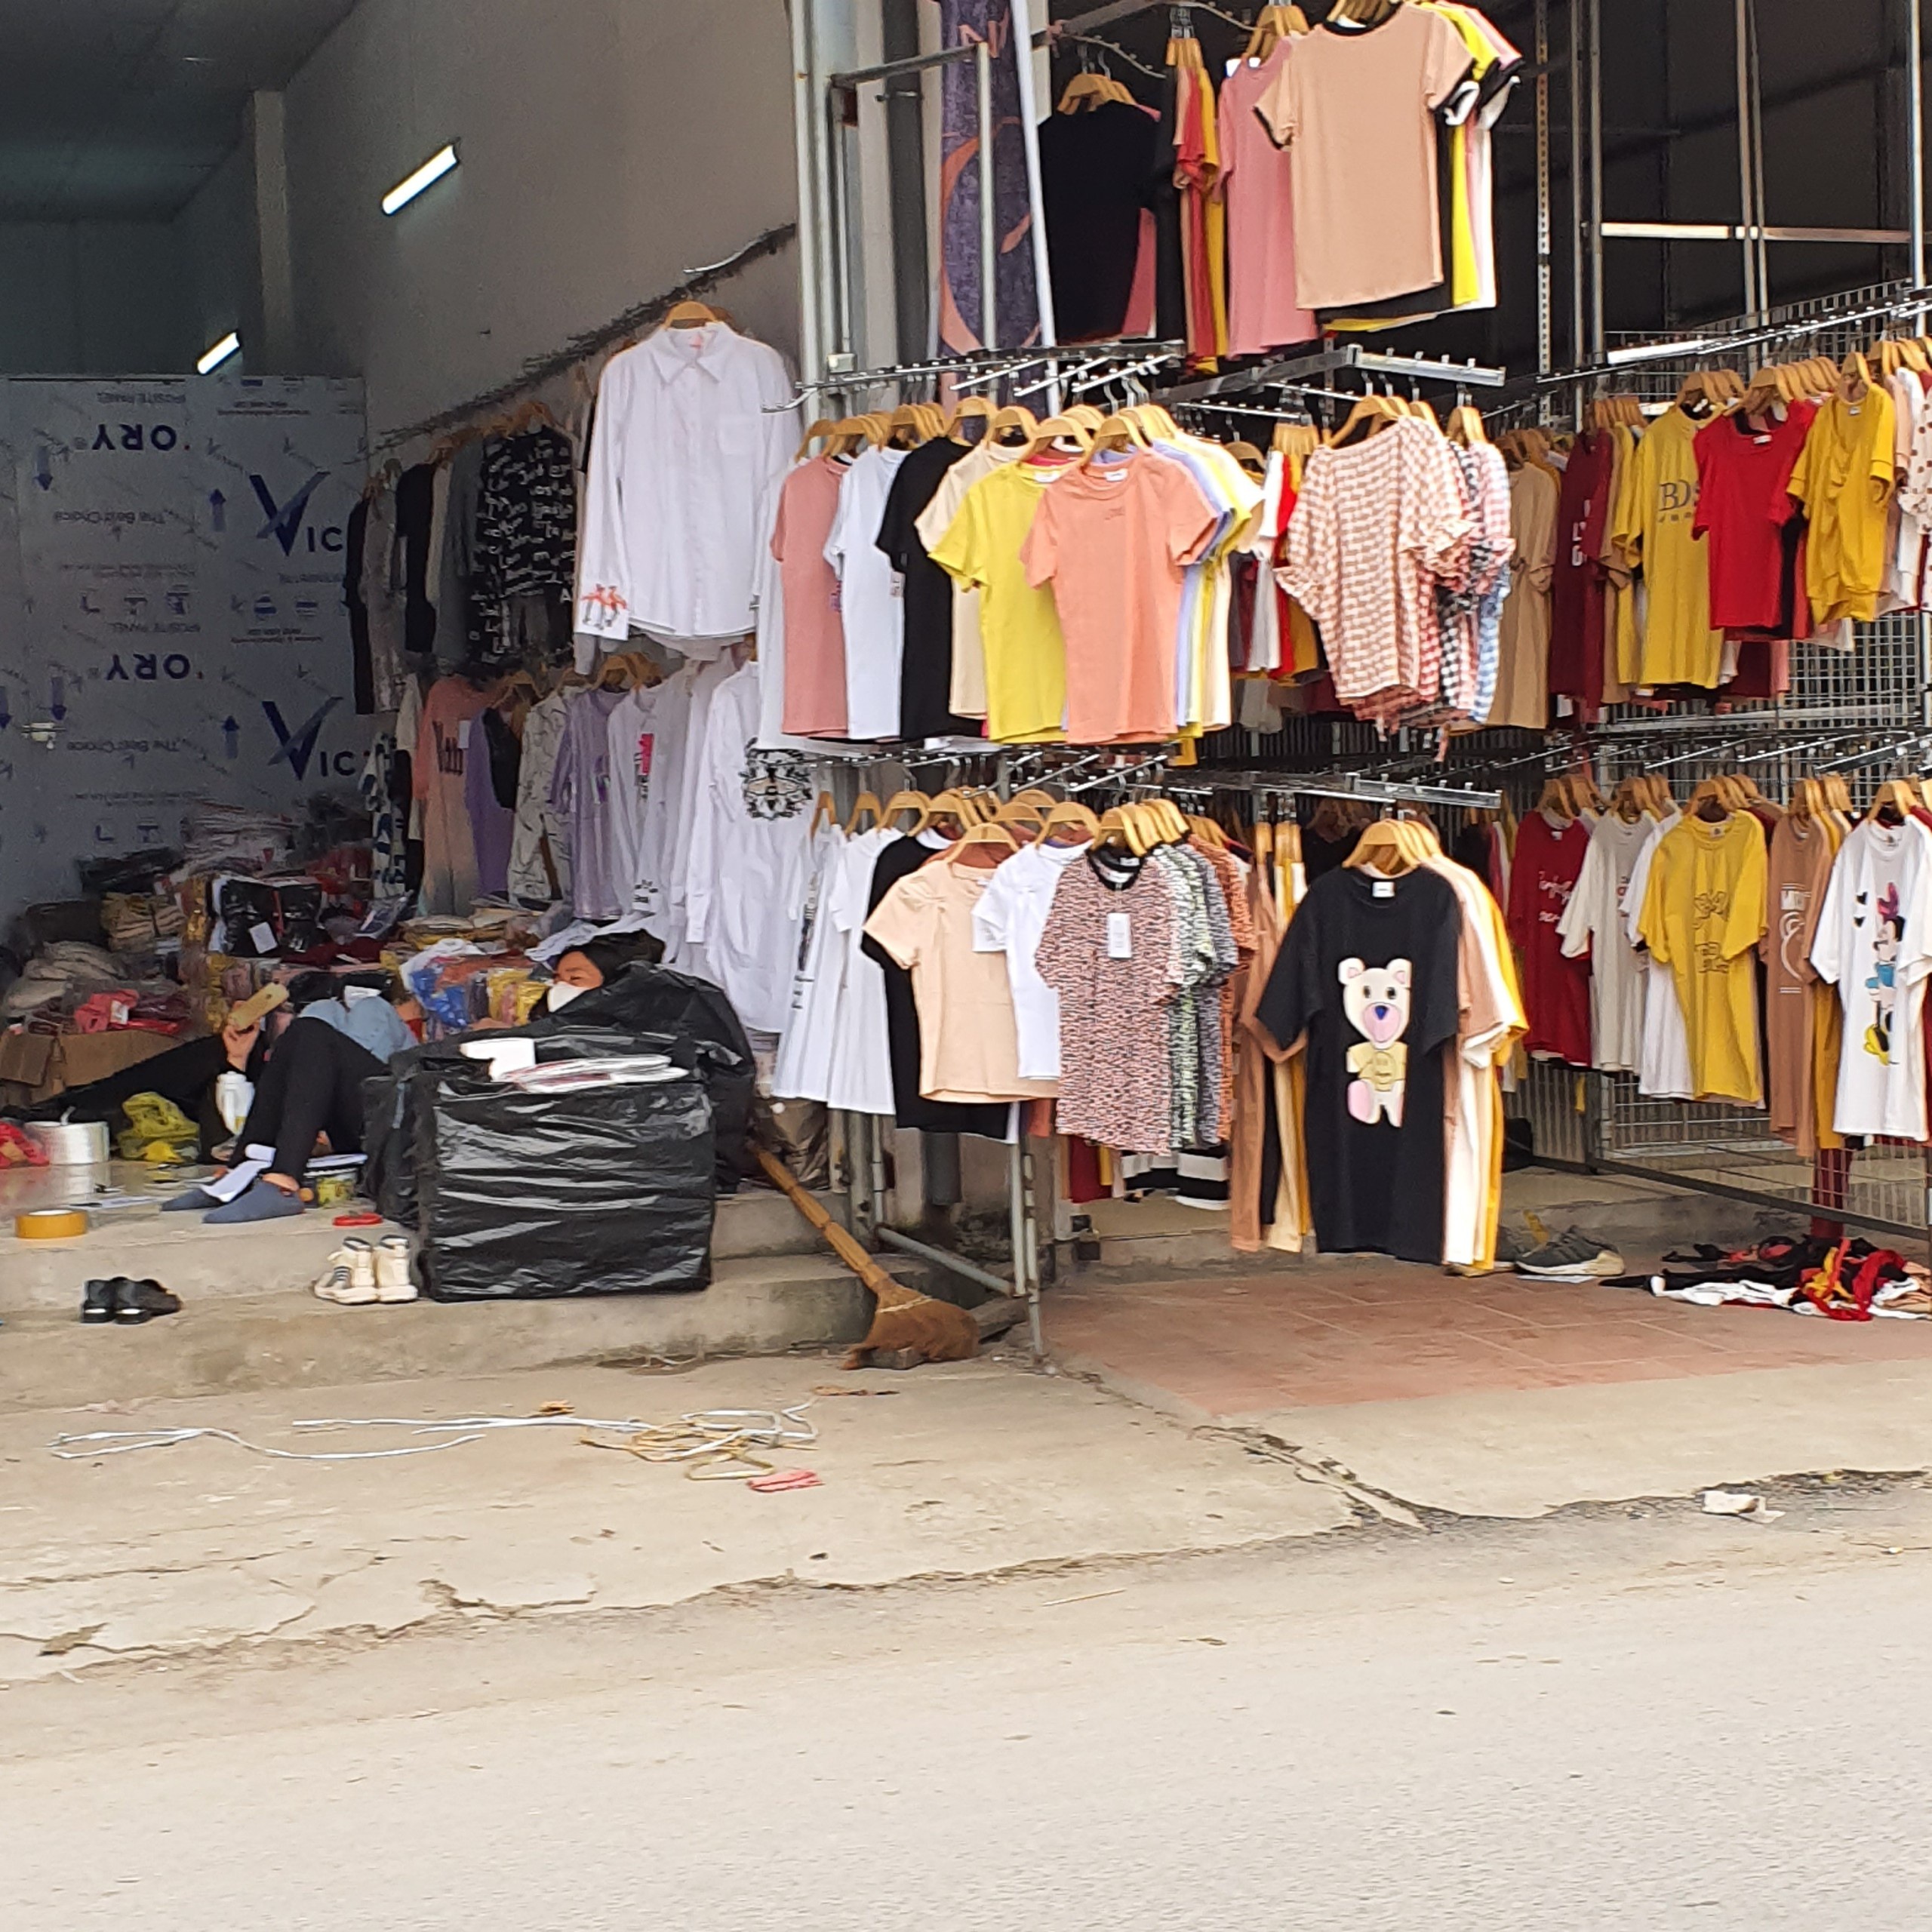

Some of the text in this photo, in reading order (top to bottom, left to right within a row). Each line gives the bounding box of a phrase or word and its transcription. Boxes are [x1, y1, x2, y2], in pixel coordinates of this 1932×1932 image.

[92, 424, 190, 451] ORY
[106, 654, 202, 680] ORY
[261, 696, 371, 781] VIC
